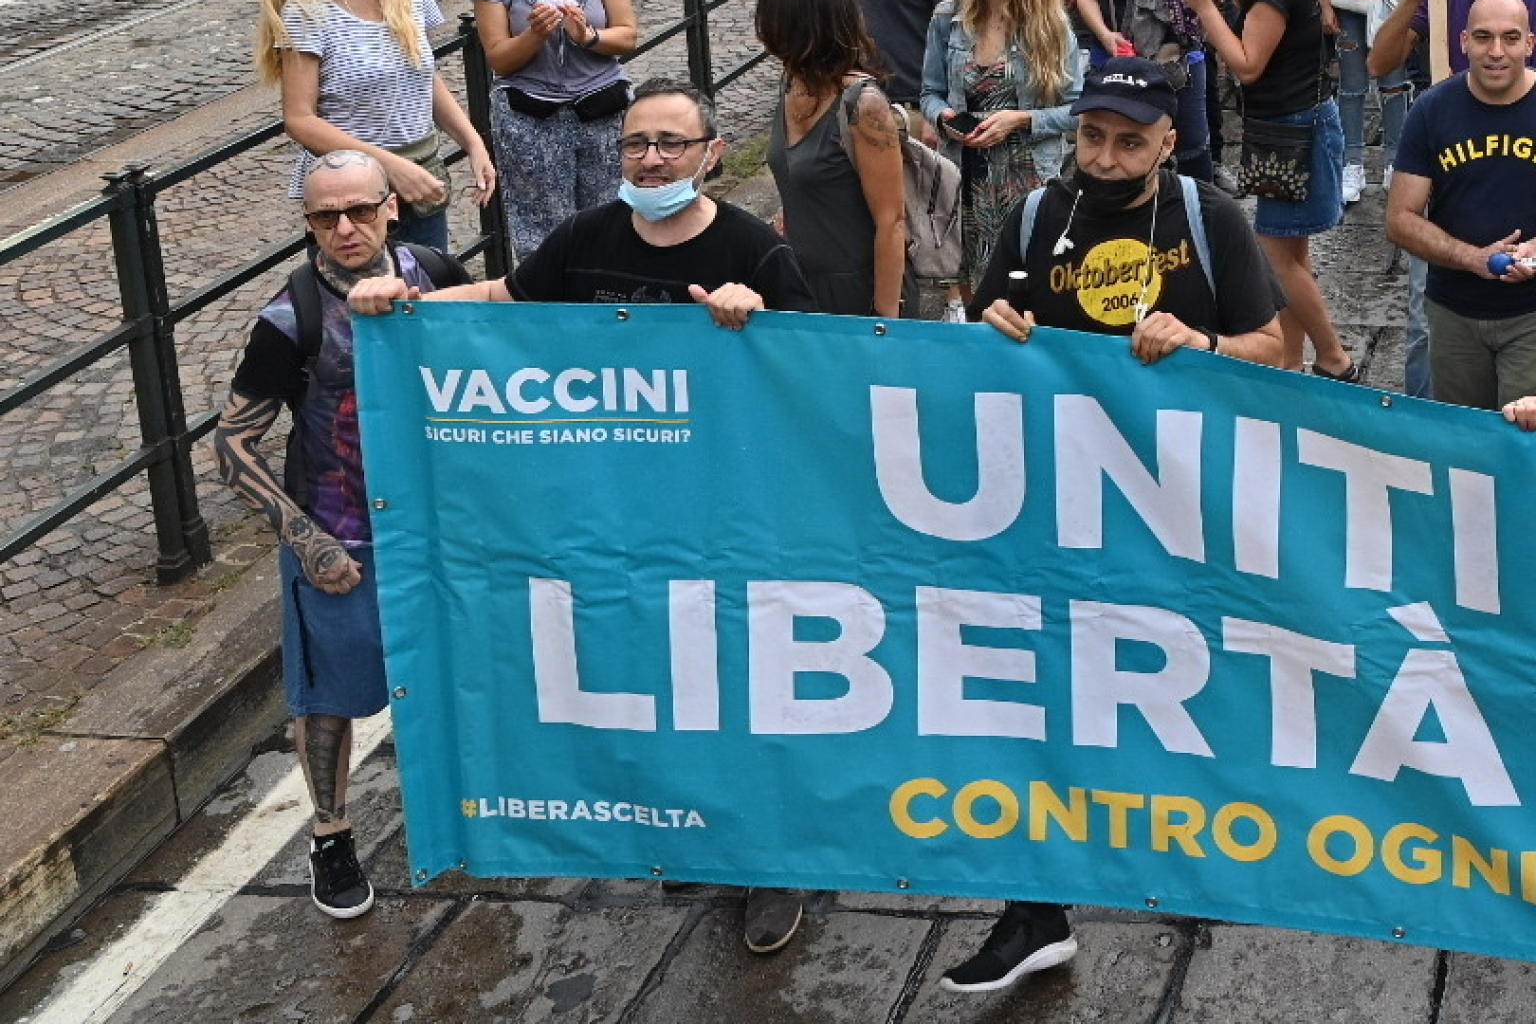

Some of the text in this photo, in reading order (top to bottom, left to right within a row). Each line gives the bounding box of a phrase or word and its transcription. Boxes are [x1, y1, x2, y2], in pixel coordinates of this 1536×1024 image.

[1049, 238, 1191, 294] Oktoberfest
[1101, 293, 1139, 312] 2006
[419, 365, 689, 415] VACCINI
[424, 425, 692, 445] SICURI CHE SIANO SICURI?
[871, 384, 1502, 616] UNITI
[528, 576, 1522, 808] LIBERTÀ
[459, 796, 707, 829] #LIBERASCELTA
[889, 777, 1277, 863] CONTRO
